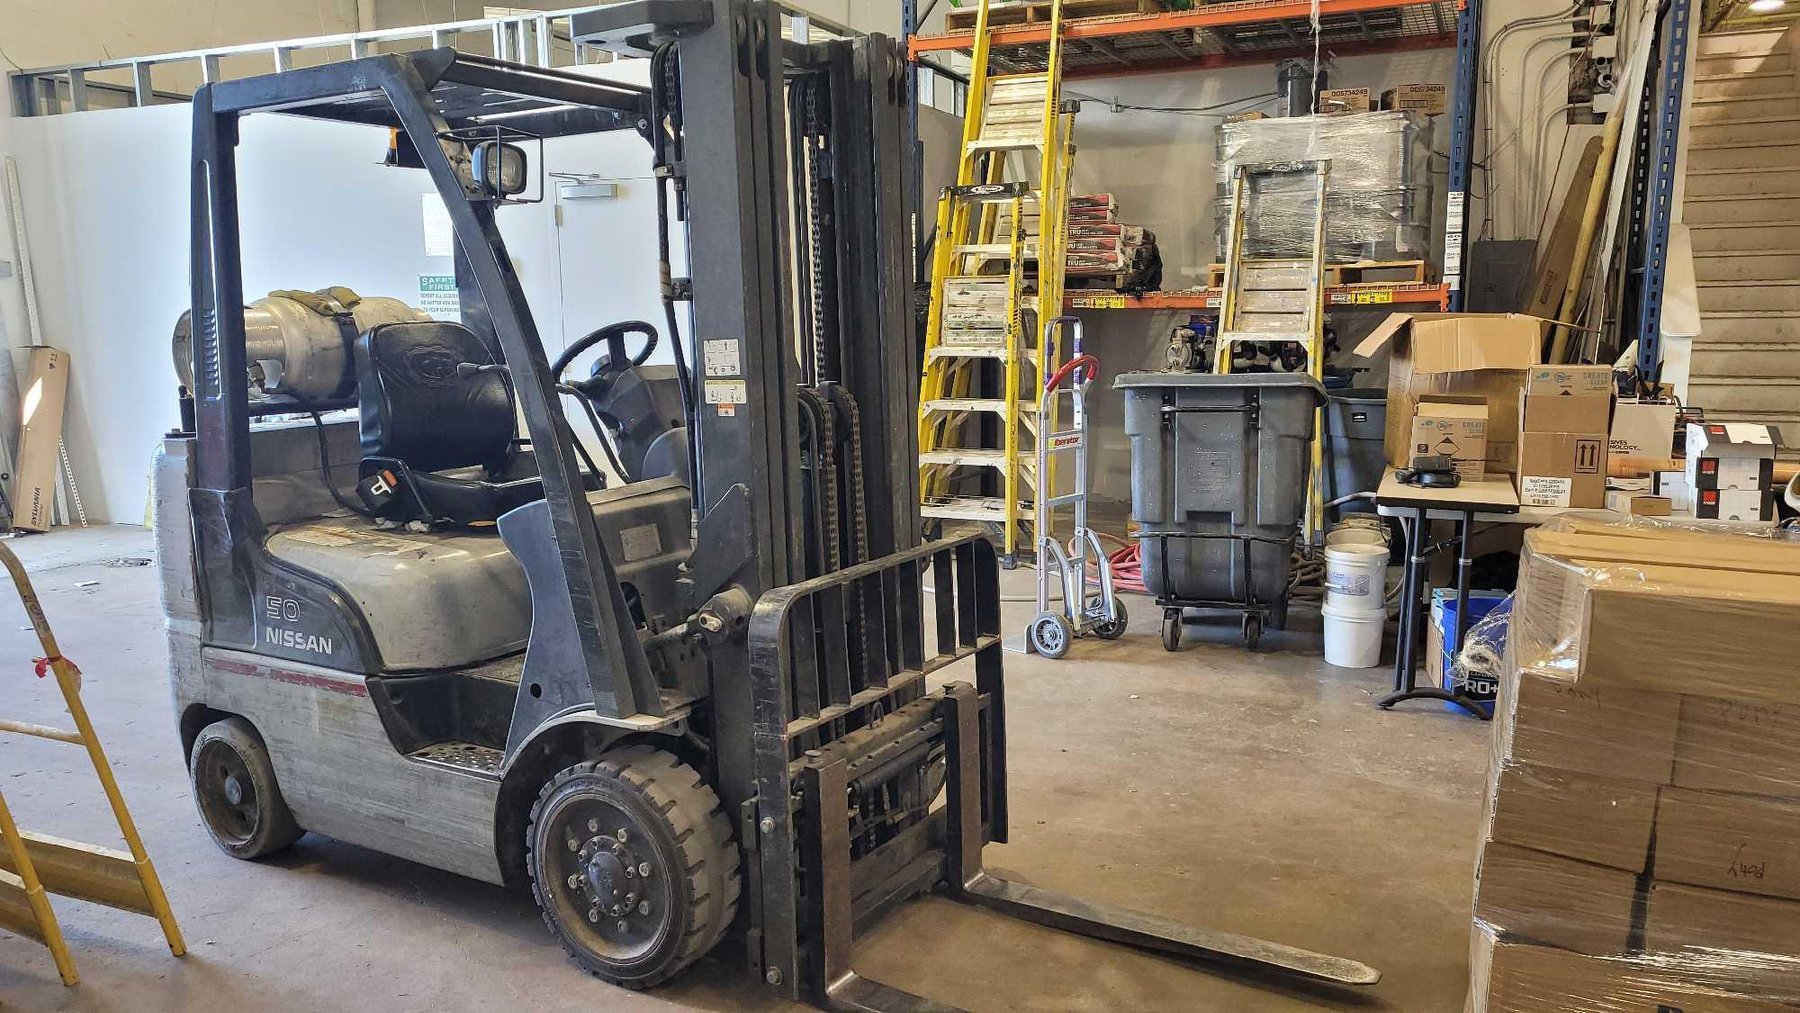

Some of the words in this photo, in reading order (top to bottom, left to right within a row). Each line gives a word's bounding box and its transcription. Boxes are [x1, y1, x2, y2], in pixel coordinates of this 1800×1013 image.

[1331, 88, 1368, 98] 005734249
[1409, 85, 1446, 94] 005734249
[422, 277, 454, 286] SAFET
[31, 487, 41, 526] SYLVANIA
[266, 595, 301, 621] 50
[266, 627, 332, 655] NISSAN
[1464, 680, 1499, 694] RO+
